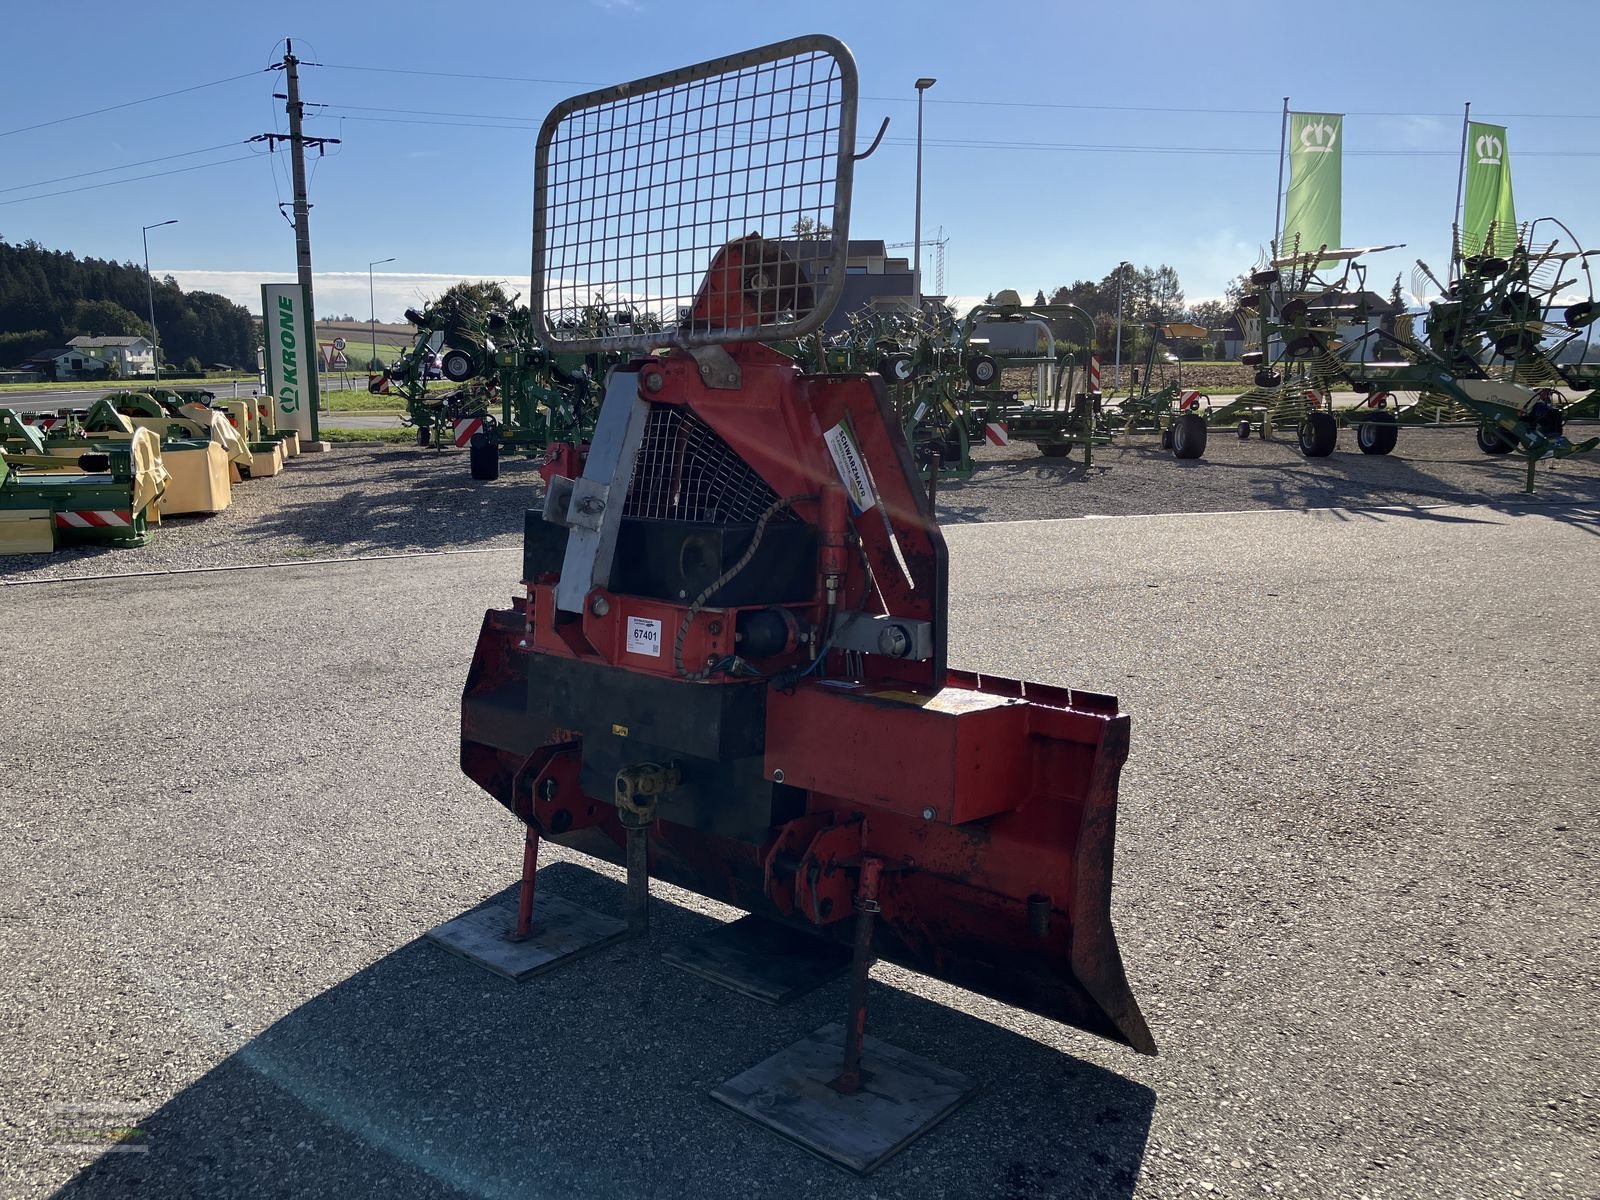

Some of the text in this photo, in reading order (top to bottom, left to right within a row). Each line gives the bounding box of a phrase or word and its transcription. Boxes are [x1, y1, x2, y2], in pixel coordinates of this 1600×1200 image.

[279, 295, 298, 385] KRONE
[336, 340, 343, 348] 70
[838, 430, 866, 497] SCHWARZMAYR
[634, 629, 656, 641] 67401
